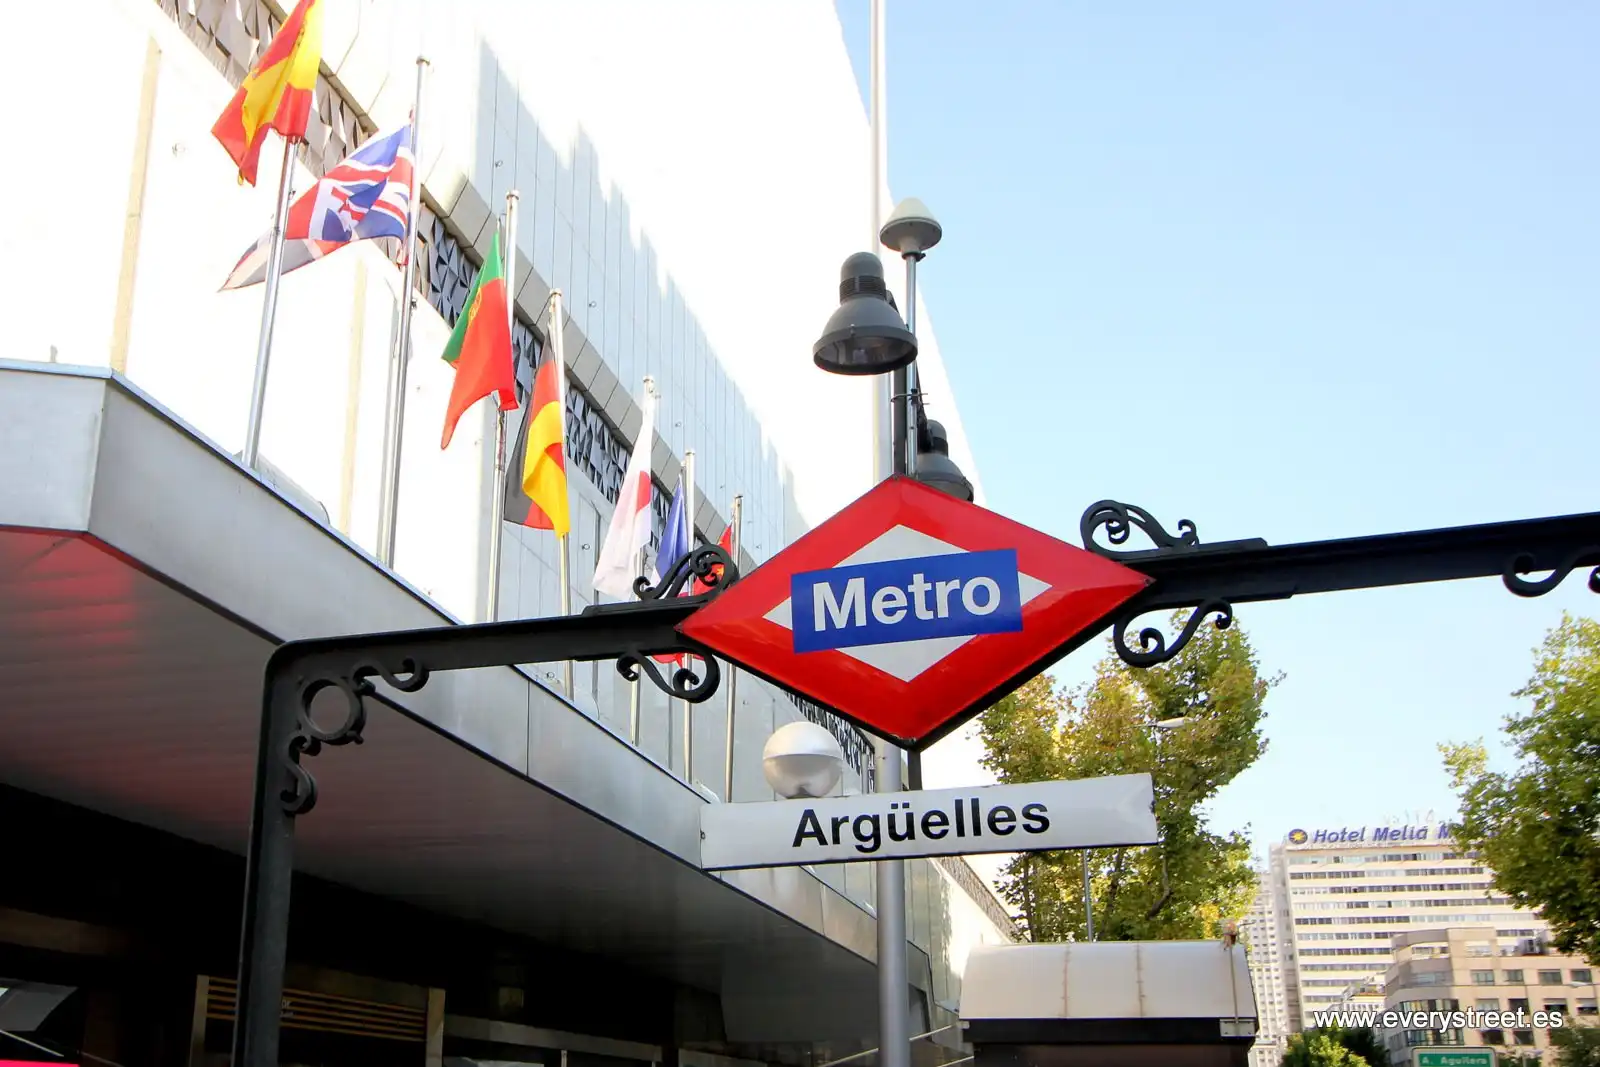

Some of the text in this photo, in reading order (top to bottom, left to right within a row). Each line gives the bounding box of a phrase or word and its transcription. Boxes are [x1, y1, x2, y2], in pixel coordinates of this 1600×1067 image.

[811, 572, 1001, 632] Metro
[792, 797, 1051, 854] Argüelles
[1313, 826, 1366, 844] Hotel
[1421, 1055, 1488, 1066] A. Aguilera
